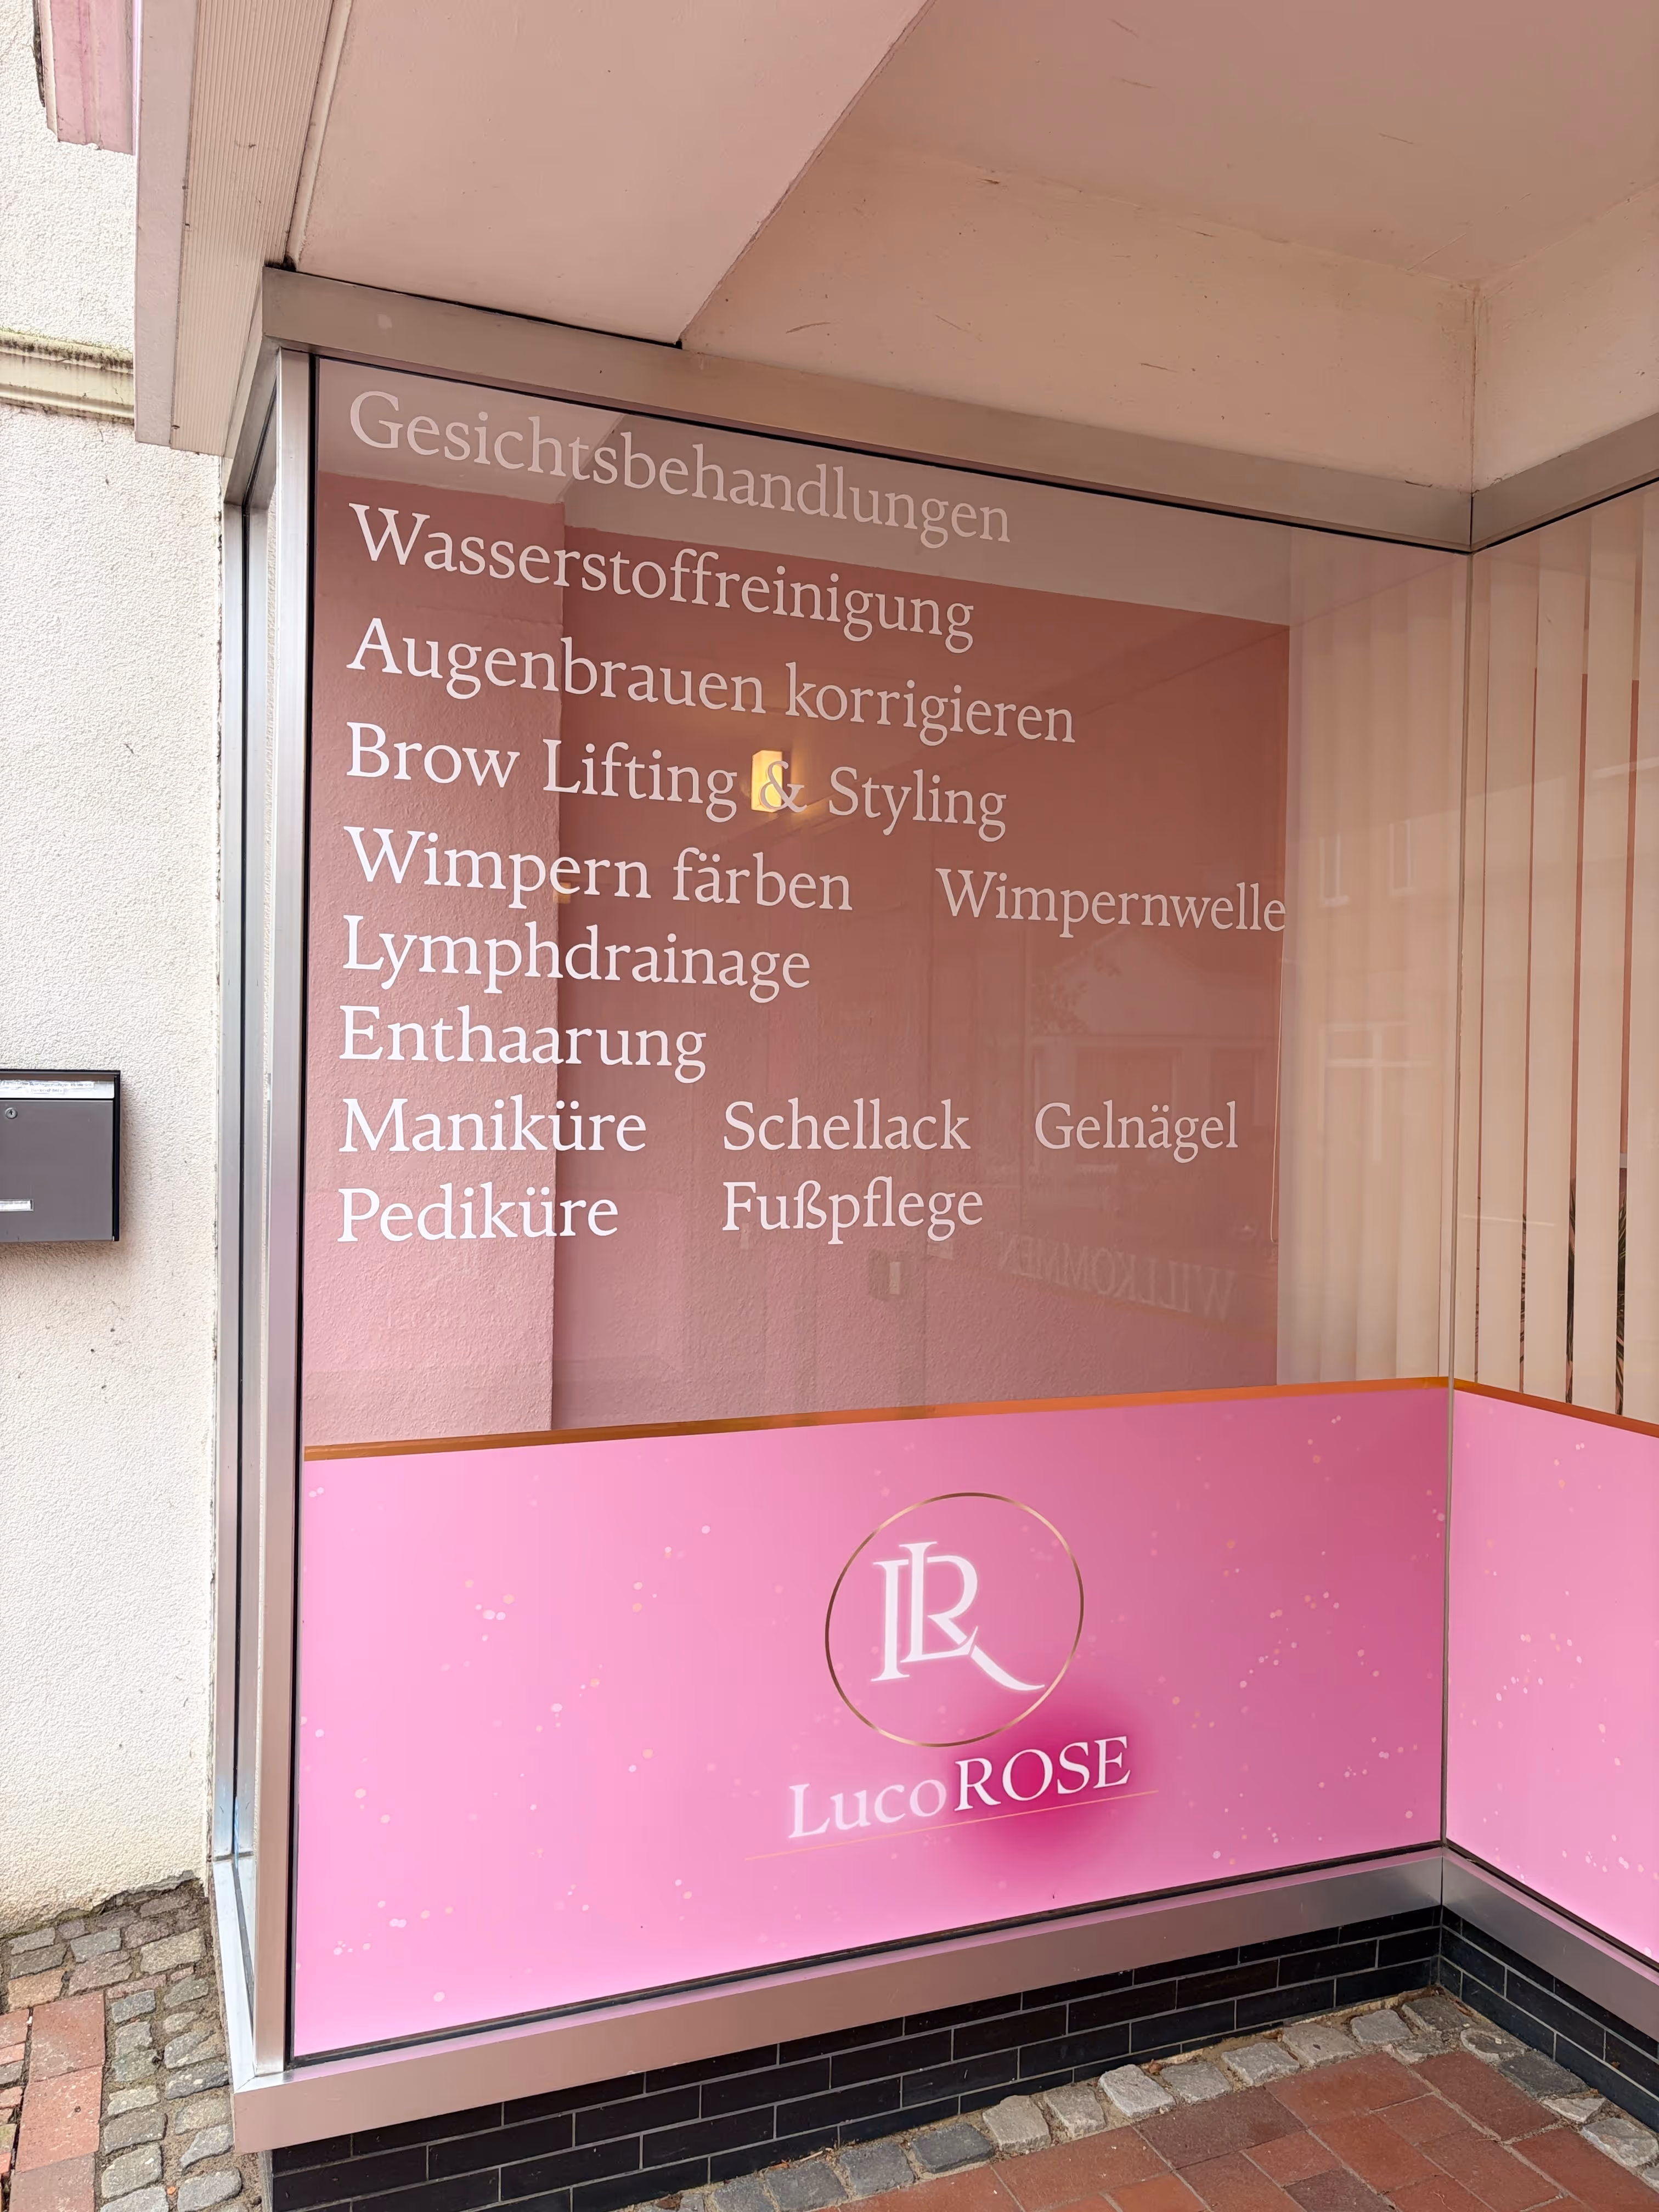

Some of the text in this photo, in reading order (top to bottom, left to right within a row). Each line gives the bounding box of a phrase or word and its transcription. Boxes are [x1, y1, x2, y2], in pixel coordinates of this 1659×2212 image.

[349, 391, 1011, 549] Gesichtsbehandlungen
[349, 503, 974, 653] Wasserstoffreinigung
[346, 618, 1076, 747] Augenbrauen korrigieren
[346, 721, 1007, 843] Brow Lifting & Styling
[344, 827, 853, 911] Wimpern färben
[935, 868, 1287, 939] Wimpernwelle
[343, 915, 811, 1003] Lymphdrainage
[339, 1005, 707, 1084] Enthaarung
[338, 1094, 646, 1153] Maniküre
[724, 1097, 971, 1150] Schellack
[1035, 1099, 1238, 1164] Gelnägel
[337, 1182, 618, 1243] Pediküre
[722, 1176, 984, 1245] Fußpflege
